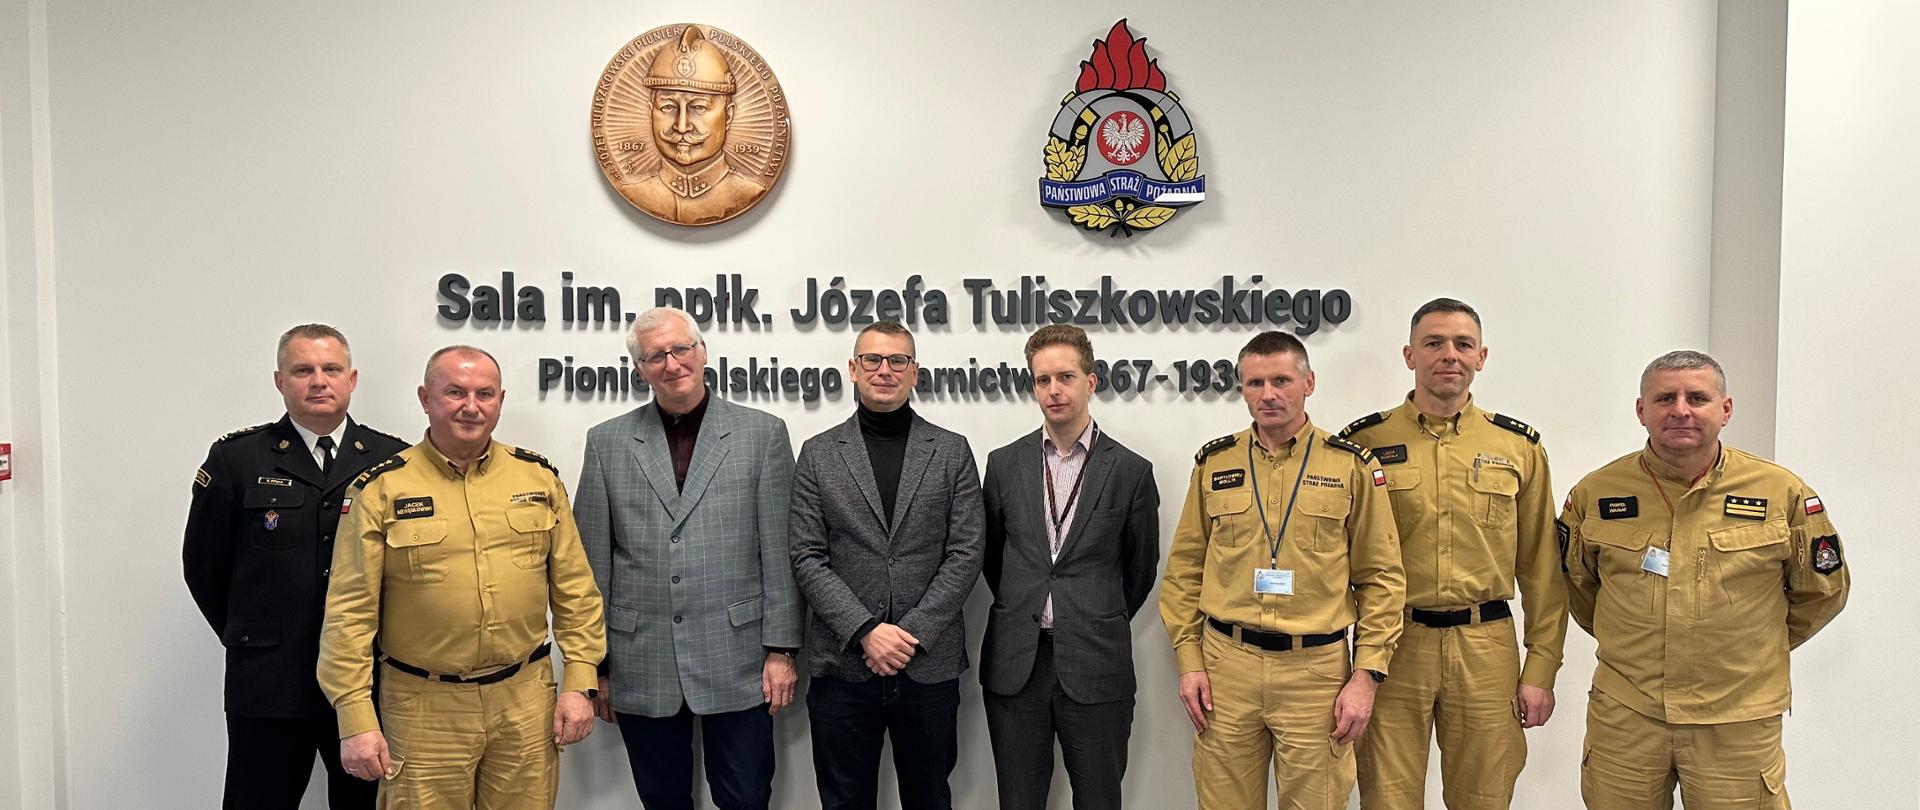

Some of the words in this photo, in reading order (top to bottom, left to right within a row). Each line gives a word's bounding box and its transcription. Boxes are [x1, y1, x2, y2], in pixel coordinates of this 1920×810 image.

[593, 47, 634, 128] TULISZKOWSKI
[618, 142, 644, 151] 1867
[735, 144, 760, 154] 1939
[1045, 182, 1106, 201] PAŃSTWOWA
[1110, 175, 1140, 191] STRAŻ
[438, 271, 545, 322] Sala
[561, 272, 636, 322] im.
[790, 275, 948, 325] Józefa
[963, 275, 1351, 334] Tuliszkowskiego
[538, 356, 650, 392] Pionie
[703, 356, 842, 400] olskiego
[854, 358, 1034, 400] arnictw
[1094, 359, 1243, 393] 867-193
